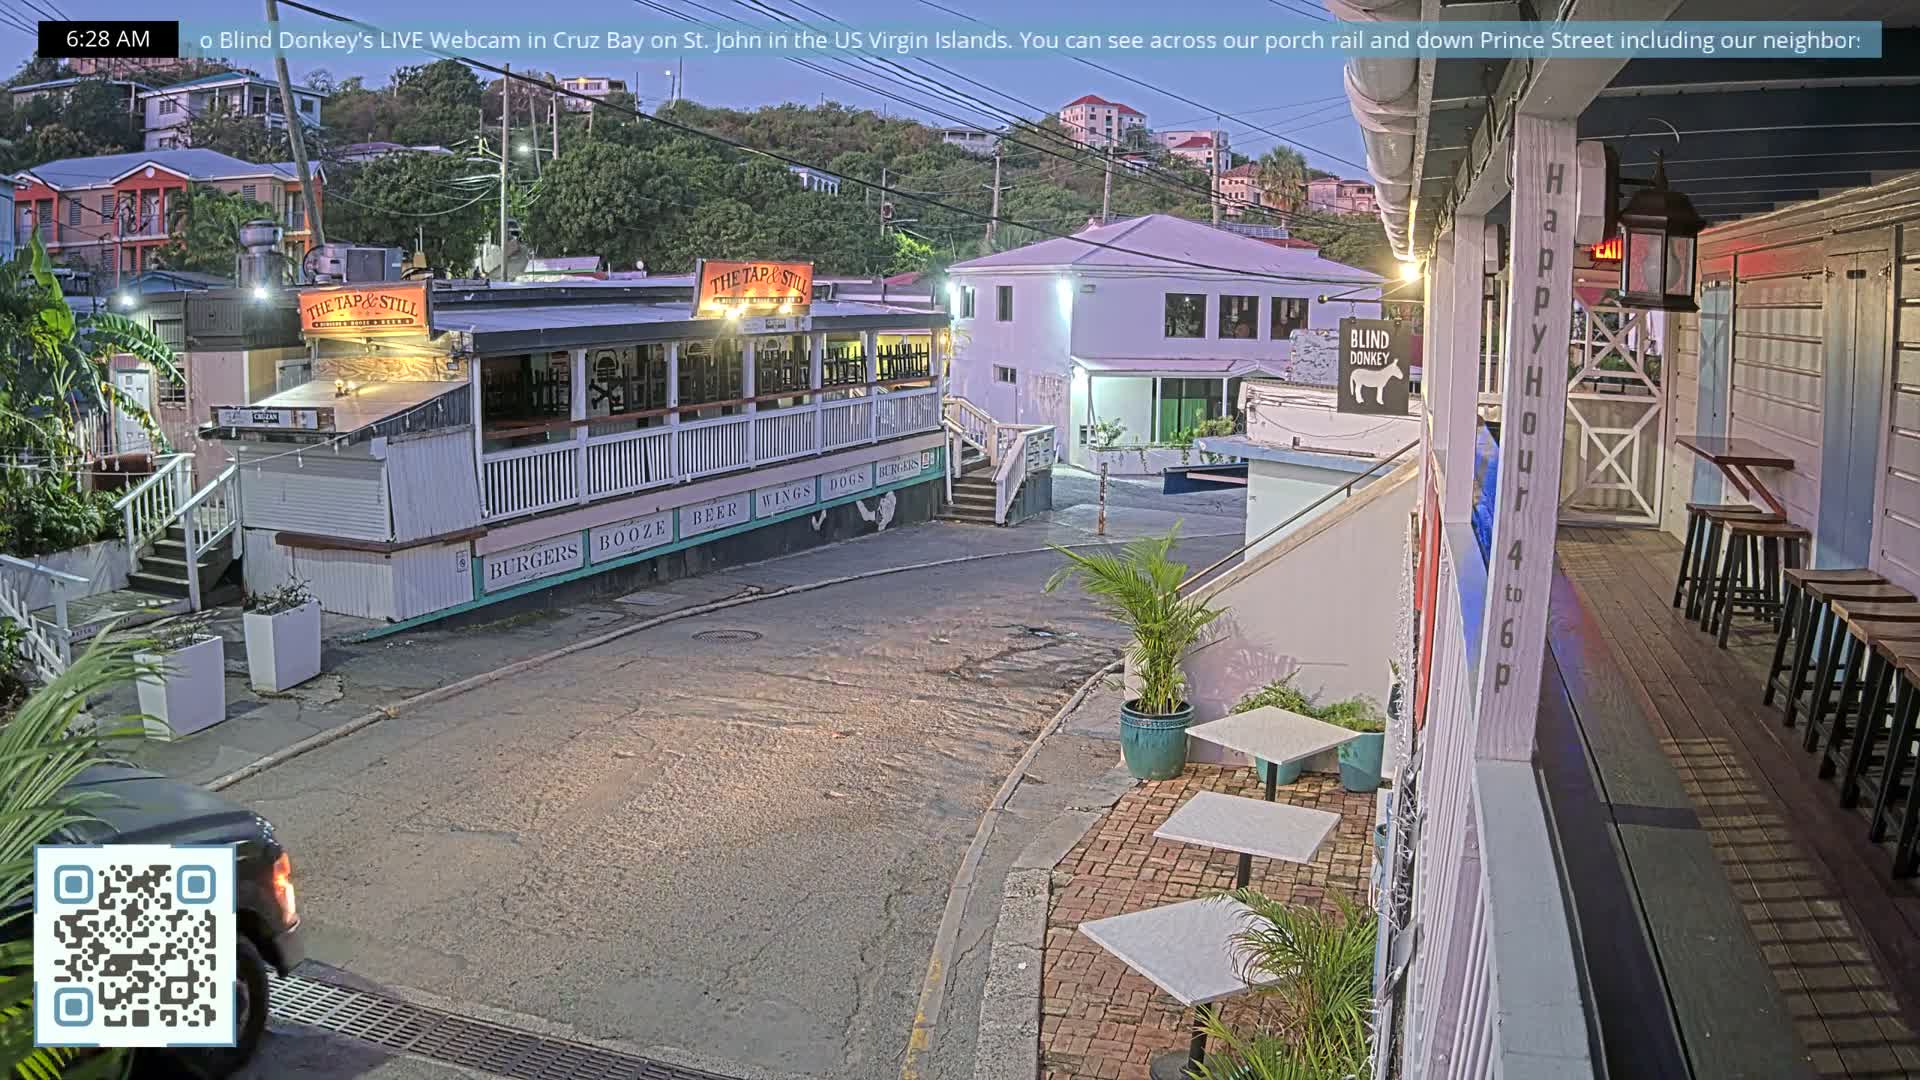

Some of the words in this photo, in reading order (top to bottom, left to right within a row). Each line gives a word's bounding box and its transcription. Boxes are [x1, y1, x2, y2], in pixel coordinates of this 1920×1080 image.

[710, 270, 741, 294] THE
[742, 266, 768, 283] TAP
[767, 266, 781, 284] &
[782, 269, 807, 296] STILL
[307, 299, 334, 320] THE
[334, 294, 362, 312] TAP
[361, 292, 378, 309] &
[379, 294, 418, 317] STILL
[1350, 329, 1389, 349] BLIND
[1350, 350, 1390, 365] DONKEY
[879, 457, 919, 478] BURGERS
[830, 472, 865, 490] DOGS
[762, 487, 811, 508] WINGS
[693, 502, 738, 526] BEER
[599, 520, 666, 551] BOOZE
[489, 543, 578, 580] BURGERS
[1507, 540, 1523, 570] 4
[1505, 584, 1522, 602] to
